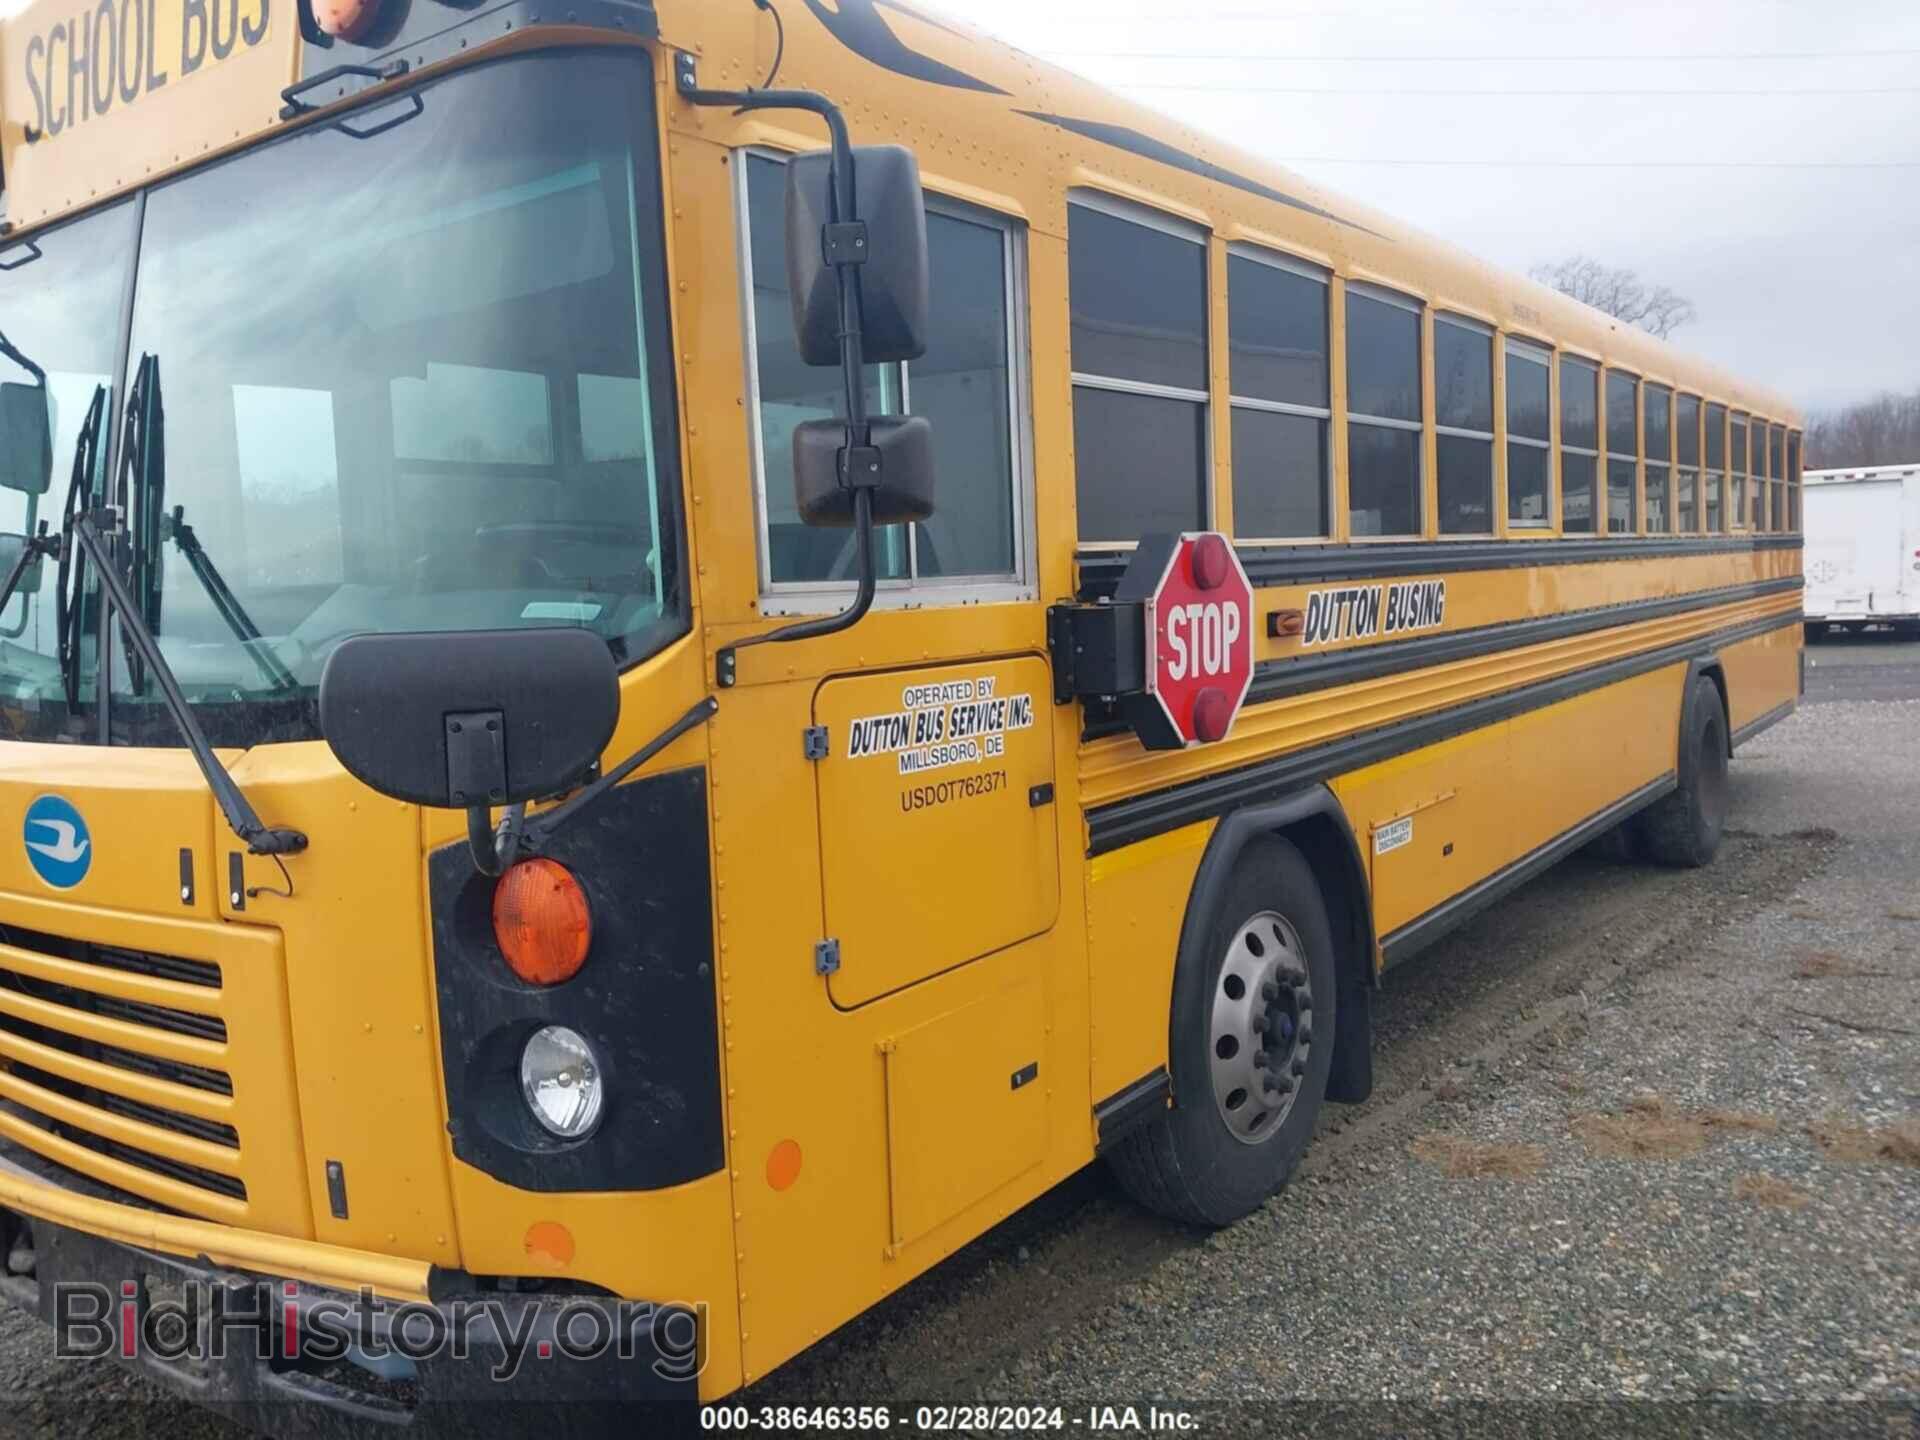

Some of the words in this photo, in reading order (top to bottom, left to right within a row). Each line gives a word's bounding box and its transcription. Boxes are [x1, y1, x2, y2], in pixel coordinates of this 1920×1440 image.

[24, 0, 168, 144] SCHOOL
[1167, 600, 1241, 682] STOP
[1303, 588, 1382, 645] DUTTON
[1384, 579, 1445, 631] BUSING
[904, 682, 973, 706] OPERATED
[978, 678, 994, 696] BY
[850, 714, 911, 755] DUTTON
[915, 709, 945, 744] BUS
[949, 699, 1005, 738] SERVICE
[1008, 696, 1032, 727] INC.
[900, 741, 982, 772] MILLSBORO,
[986, 736, 1003, 754] DE
[901, 770, 1008, 812] USDOT762371
